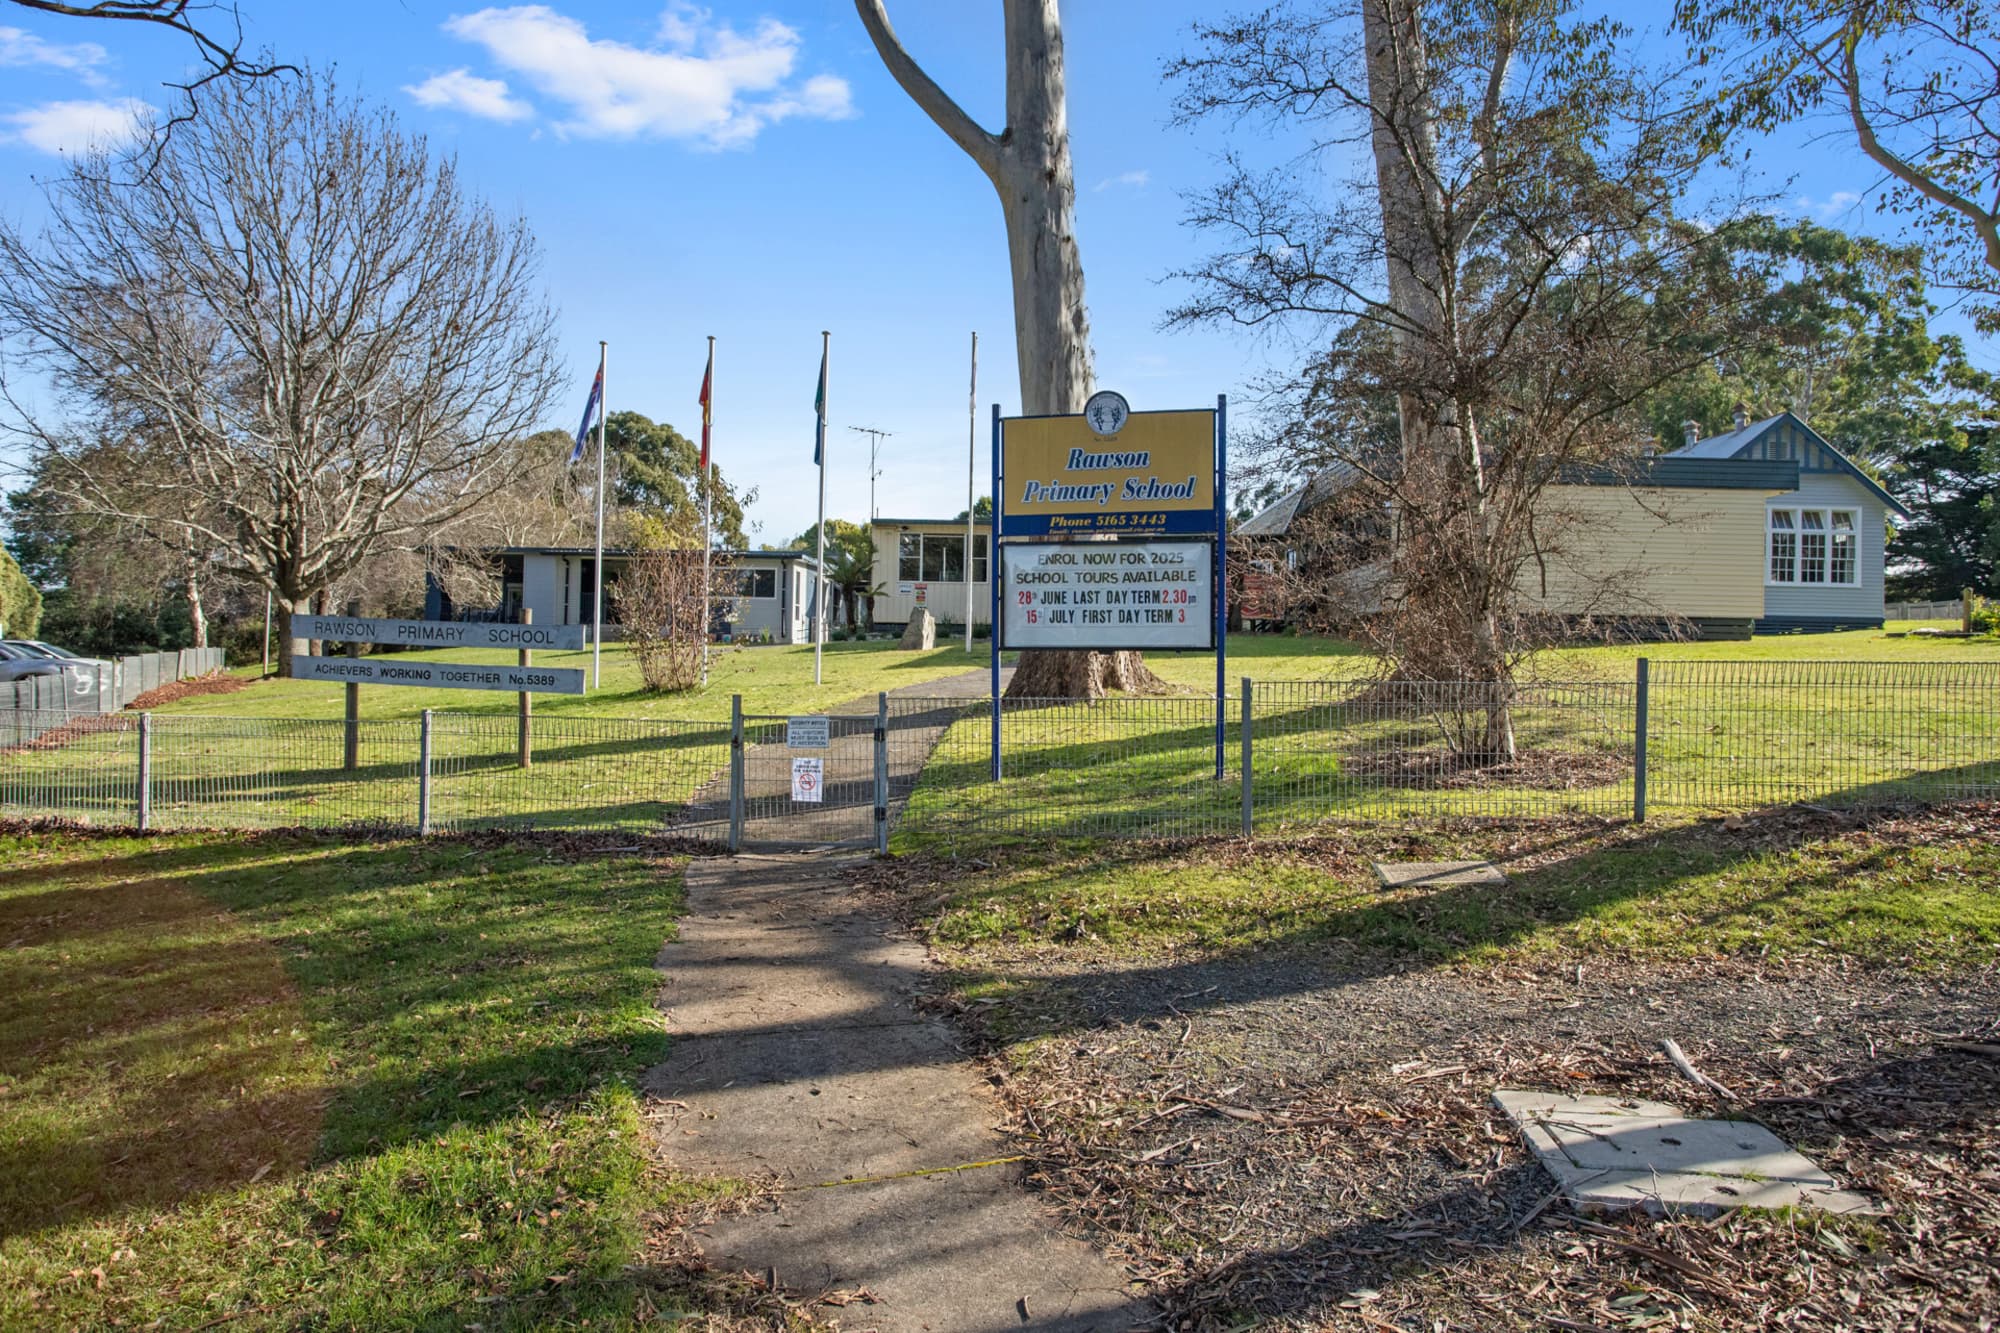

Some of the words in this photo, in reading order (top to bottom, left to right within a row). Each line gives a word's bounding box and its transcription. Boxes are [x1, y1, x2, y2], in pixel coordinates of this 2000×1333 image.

[1065, 448, 1150, 471] Rawson
[1021, 480, 1116, 505] Primary
[1120, 475, 1197, 500] School
[1050, 516, 1092, 527] Phone
[1096, 515, 1127, 526] 5165
[1130, 514, 1167, 525] 3443
[1038, 553, 1079, 565] ENROL
[1083, 553, 1116, 565] NOW
[1120, 553, 1146, 564] FOR
[1151, 552, 1184, 564] 2025
[1016, 572, 1069, 584] SCHOOL
[1075, 571, 1119, 584] TOURS
[1122, 570, 1197, 583] AVAILABLE
[1040, 591, 1067, 605] JUNE
[1073, 591, 1100, 604] LAST
[1107, 590, 1128, 604] DAY
[1131, 590, 1161, 604] TERM
[1049, 610, 1075, 624] JULY
[1082, 609, 1112, 623] FIRST
[1118, 609, 1140, 623] DAY
[1144, 609, 1173, 623] TERM
[1178, 608, 1185, 623] 3
[315, 621, 376, 637] RAWSON
[398, 625, 465, 641] PRIMARY
[488, 629, 555, 644] SCHOOL
[315, 664, 373, 677] ACHIEVERS
[380, 667, 432, 680] WORKING
[440, 671, 500, 683] TOGETHER
[508, 674, 555, 686] No.5389
